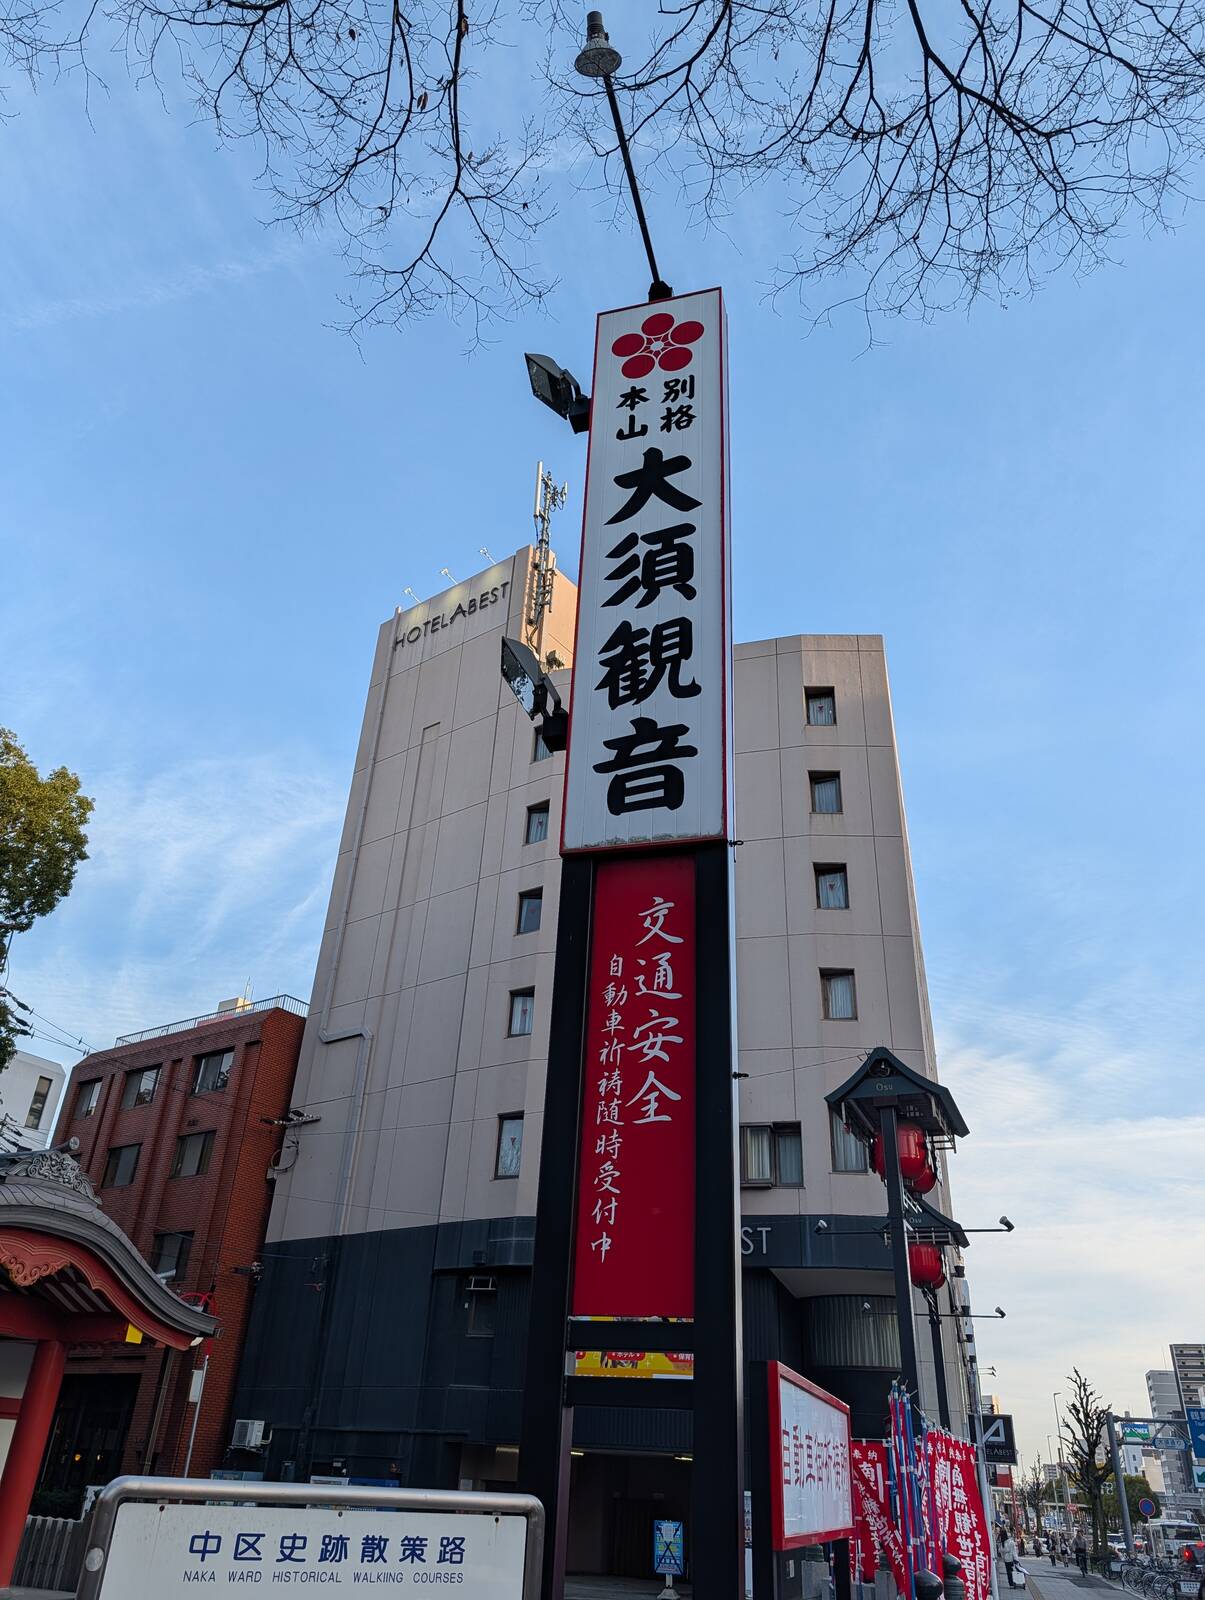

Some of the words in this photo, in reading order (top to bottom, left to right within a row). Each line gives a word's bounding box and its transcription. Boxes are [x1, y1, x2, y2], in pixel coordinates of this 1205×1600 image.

[615, 385, 651, 440] 本山
[660, 368, 696, 433] 別格
[593, 447, 703, 816] 大須観音
[625, 896, 684, 1124] 交通安全
[876, 1082, 893, 1091] Osu
[188, 1530, 466, 1565] 中区史跡散策路
[183, 1571, 216, 1583] NAKA
[228, 1571, 262, 1583] WARD
[272, 1571, 342, 1584] HISTORICAL
[412, 1572, 464, 1584] COURSES
